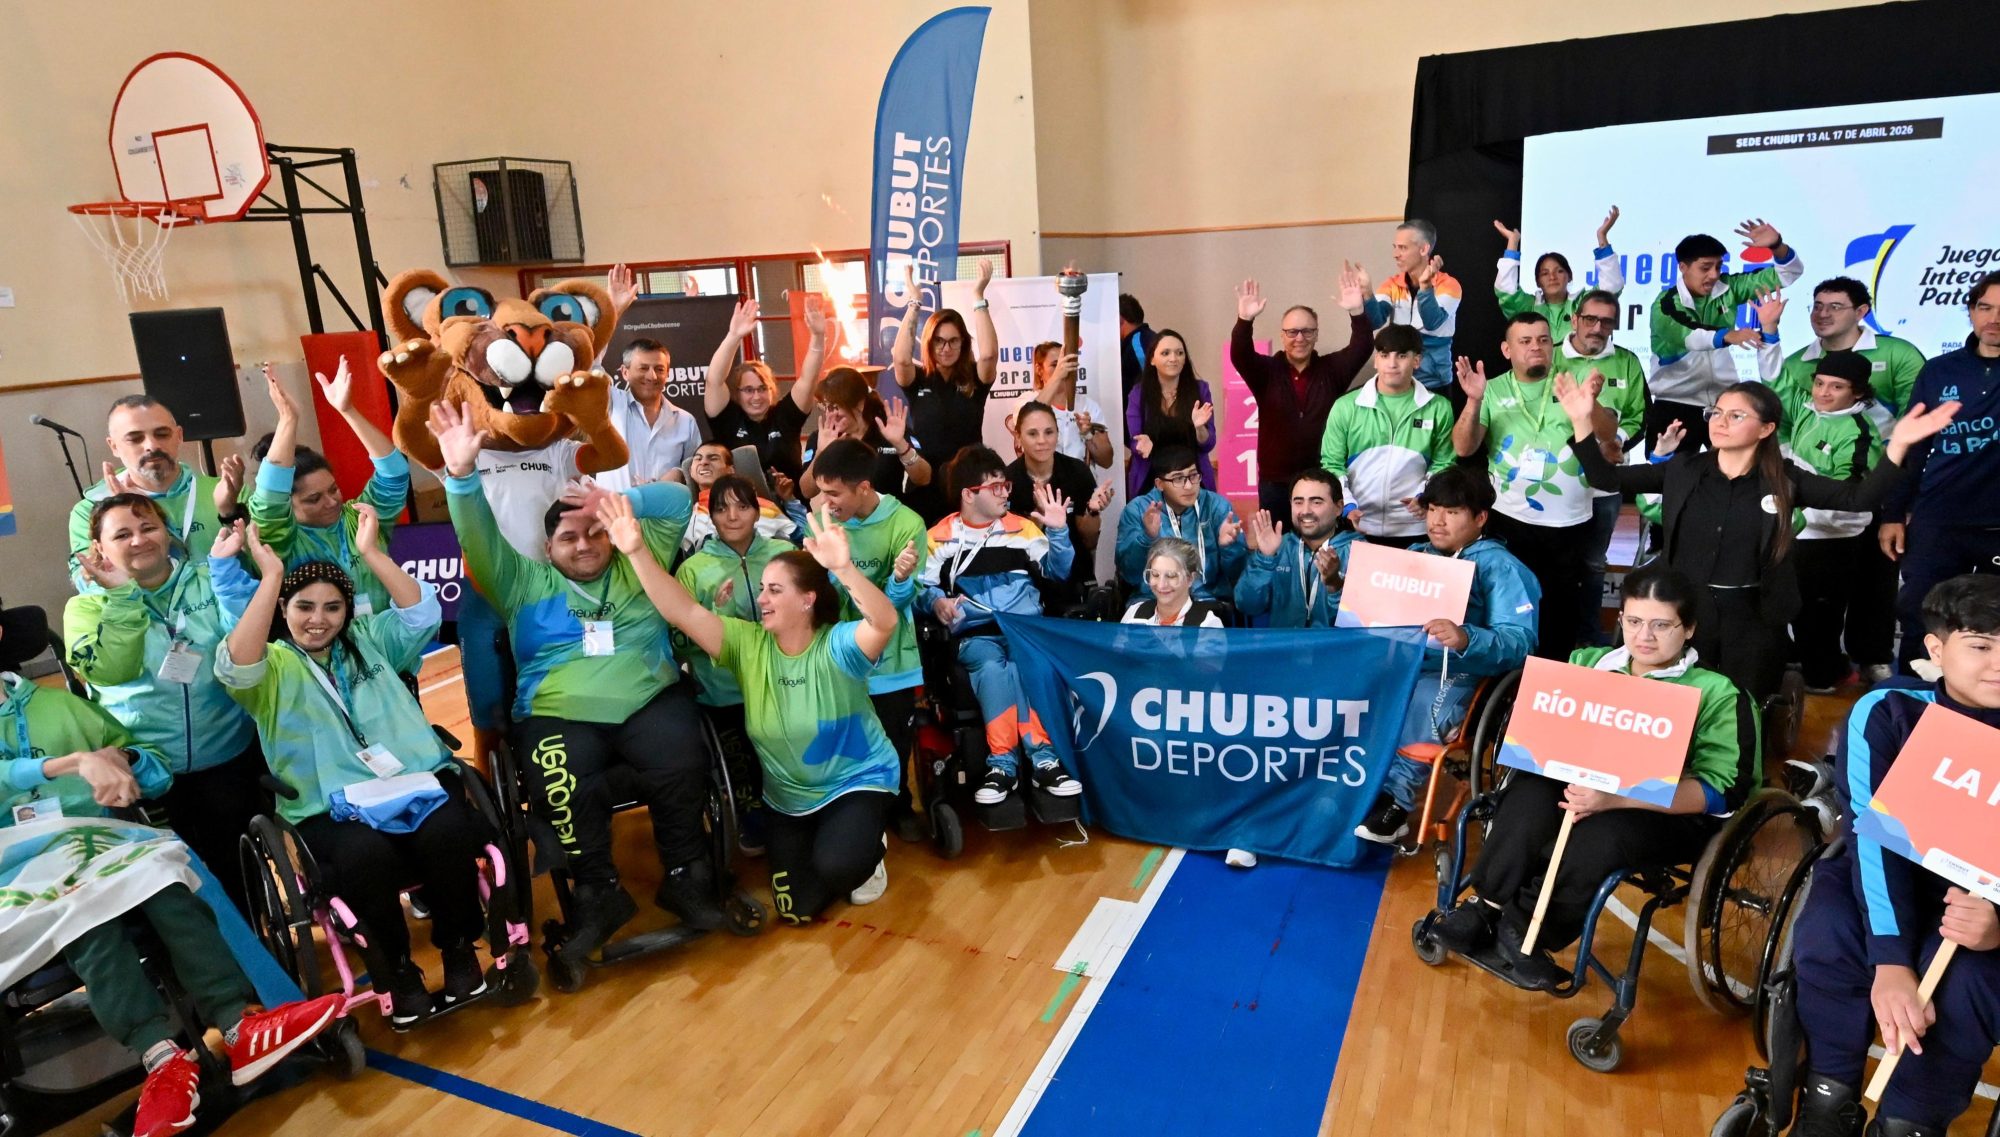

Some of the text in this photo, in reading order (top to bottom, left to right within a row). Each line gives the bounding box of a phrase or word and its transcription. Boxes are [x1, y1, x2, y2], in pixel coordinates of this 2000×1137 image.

[1736, 125, 1914, 148] SEDE CHUBUT 13 AL 17 DE ABRIL 2026
[1919, 267, 1987, 286] Integ
[1942, 385, 1958, 397] LA
[1942, 440, 1962, 454] La
[1236, 449, 1257, 486] 1
[1370, 571, 1445, 599] CHUBUT
[1131, 687, 1369, 741] CHUBUT
[1532, 689, 1673, 739] RÍO NEGRO
[1131, 737, 1367, 787] DEPORTES
[1932, 757, 1982, 798] LA
